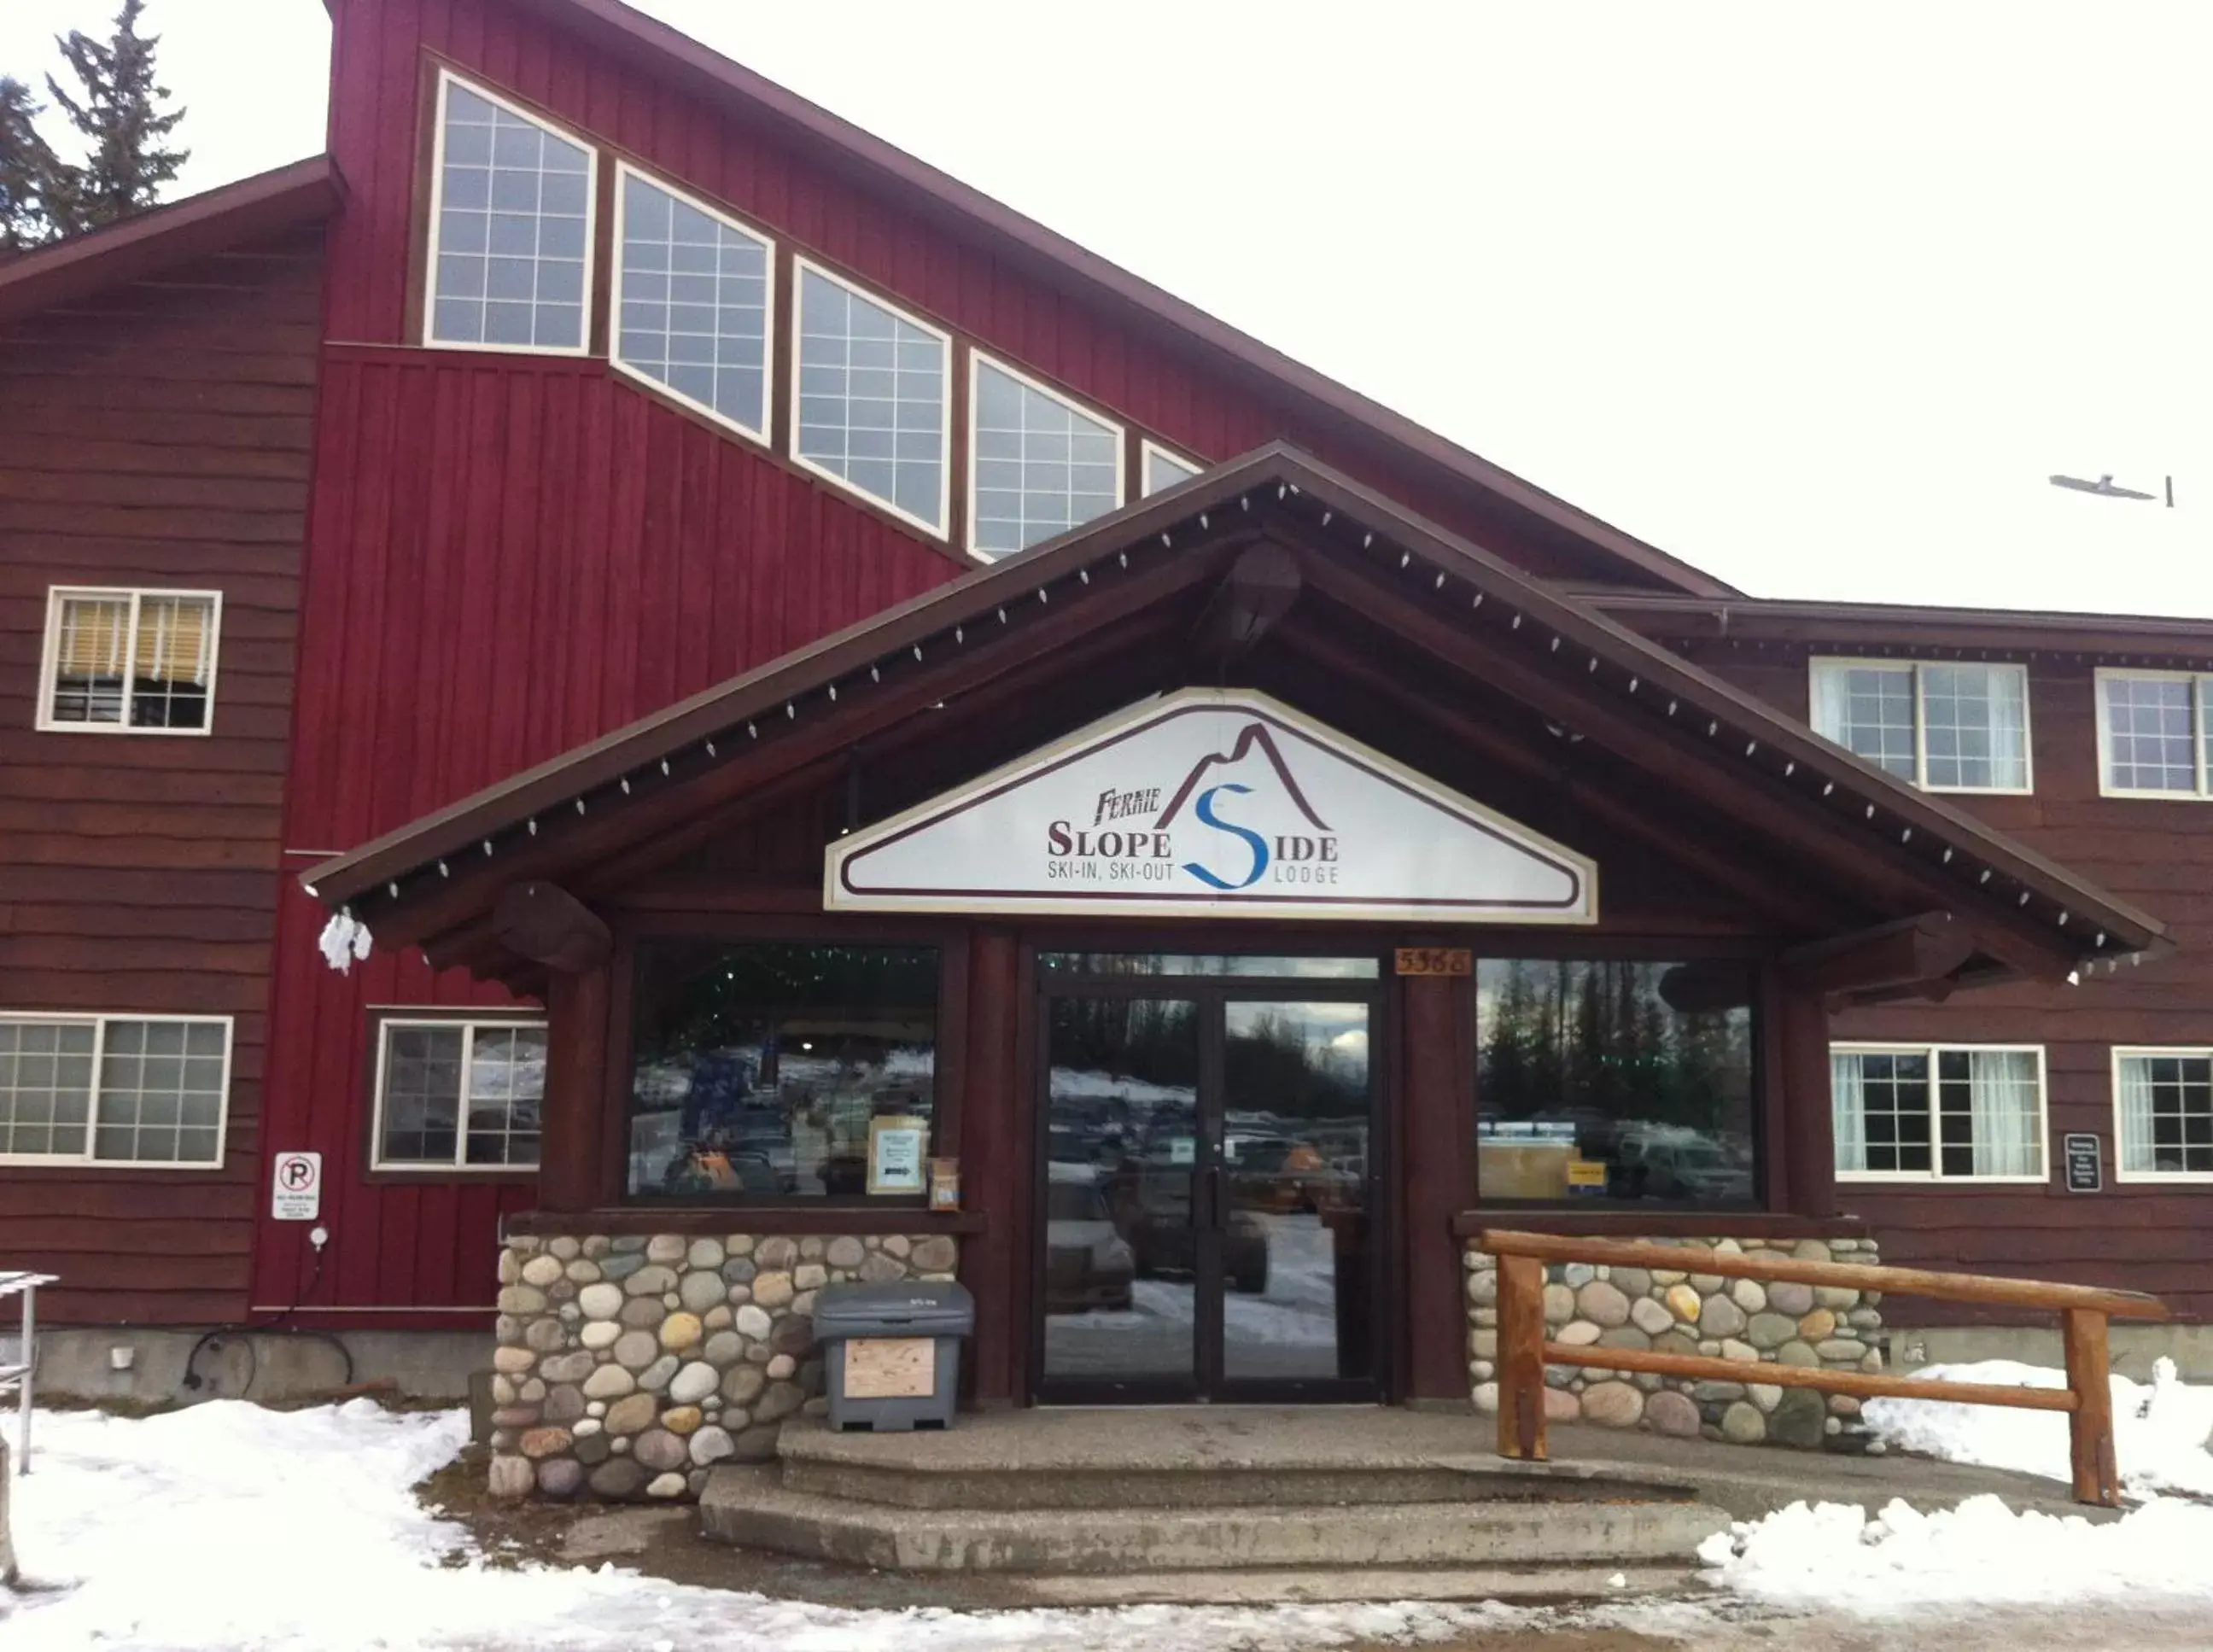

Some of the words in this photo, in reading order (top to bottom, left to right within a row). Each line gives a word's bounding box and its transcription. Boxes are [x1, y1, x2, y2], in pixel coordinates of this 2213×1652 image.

[1094, 787, 1161, 826] FERNIE
[1048, 861, 1102, 881] SKI-IN,
[1109, 862, 1175, 881] SKI-OUT
[1274, 865, 1338, 884] LODGE
